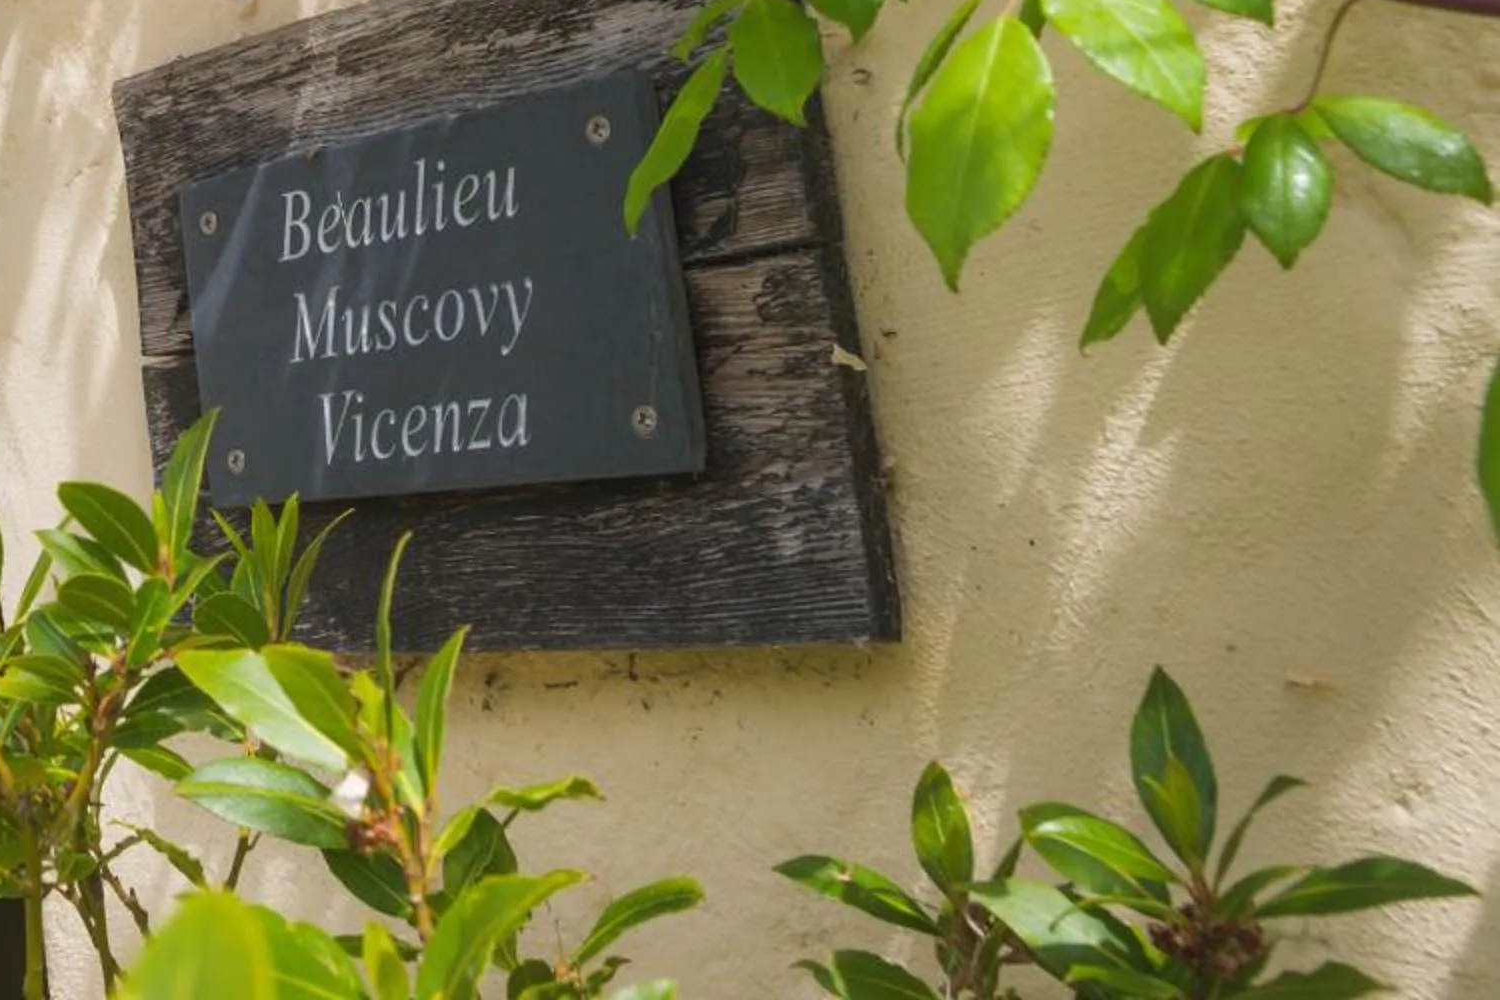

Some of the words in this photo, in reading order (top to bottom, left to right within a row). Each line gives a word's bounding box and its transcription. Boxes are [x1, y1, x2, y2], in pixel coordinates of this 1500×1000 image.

[279, 158, 520, 262] Beaulieu
[291, 277, 533, 363] Muscovy
[319, 390, 530, 466] Vicenza
